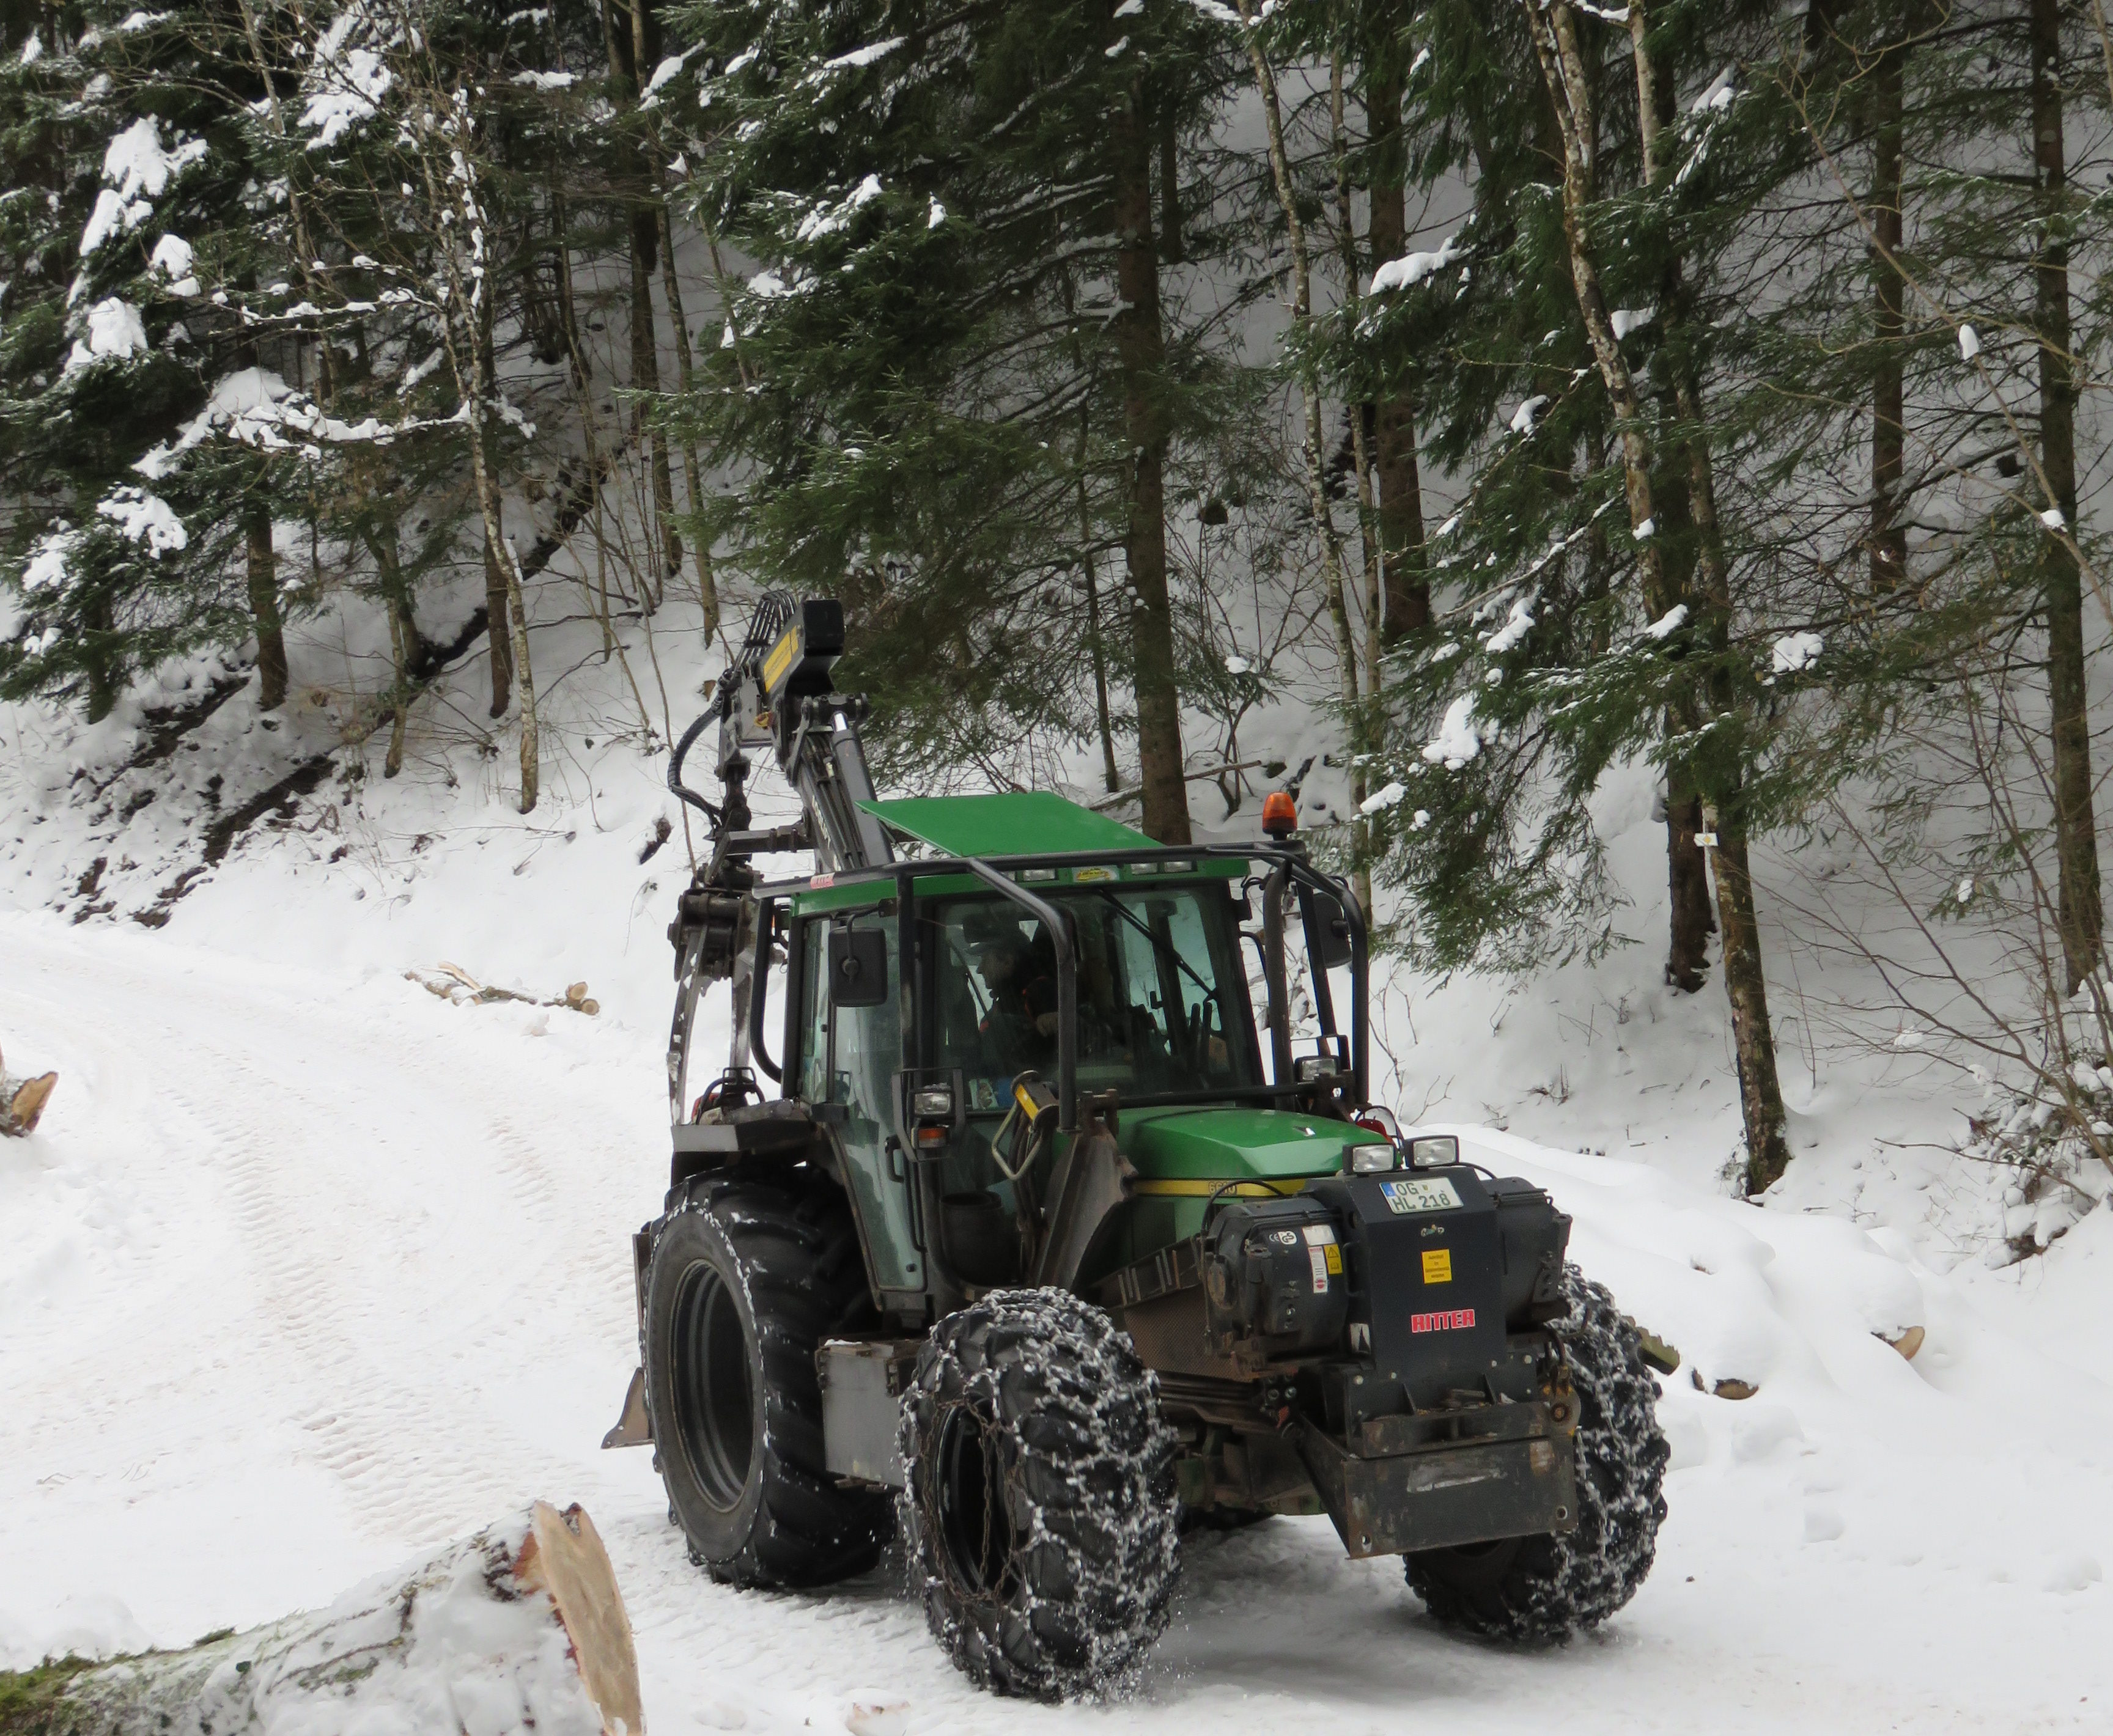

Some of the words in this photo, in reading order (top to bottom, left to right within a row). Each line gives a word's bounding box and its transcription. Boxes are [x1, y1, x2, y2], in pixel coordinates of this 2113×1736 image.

[1396, 1182, 1419, 1196] OG
[1392, 1194, 1417, 1211] HL
[1418, 1193, 1451, 1208] 218
[1411, 1309, 1475, 1333] RITTER
